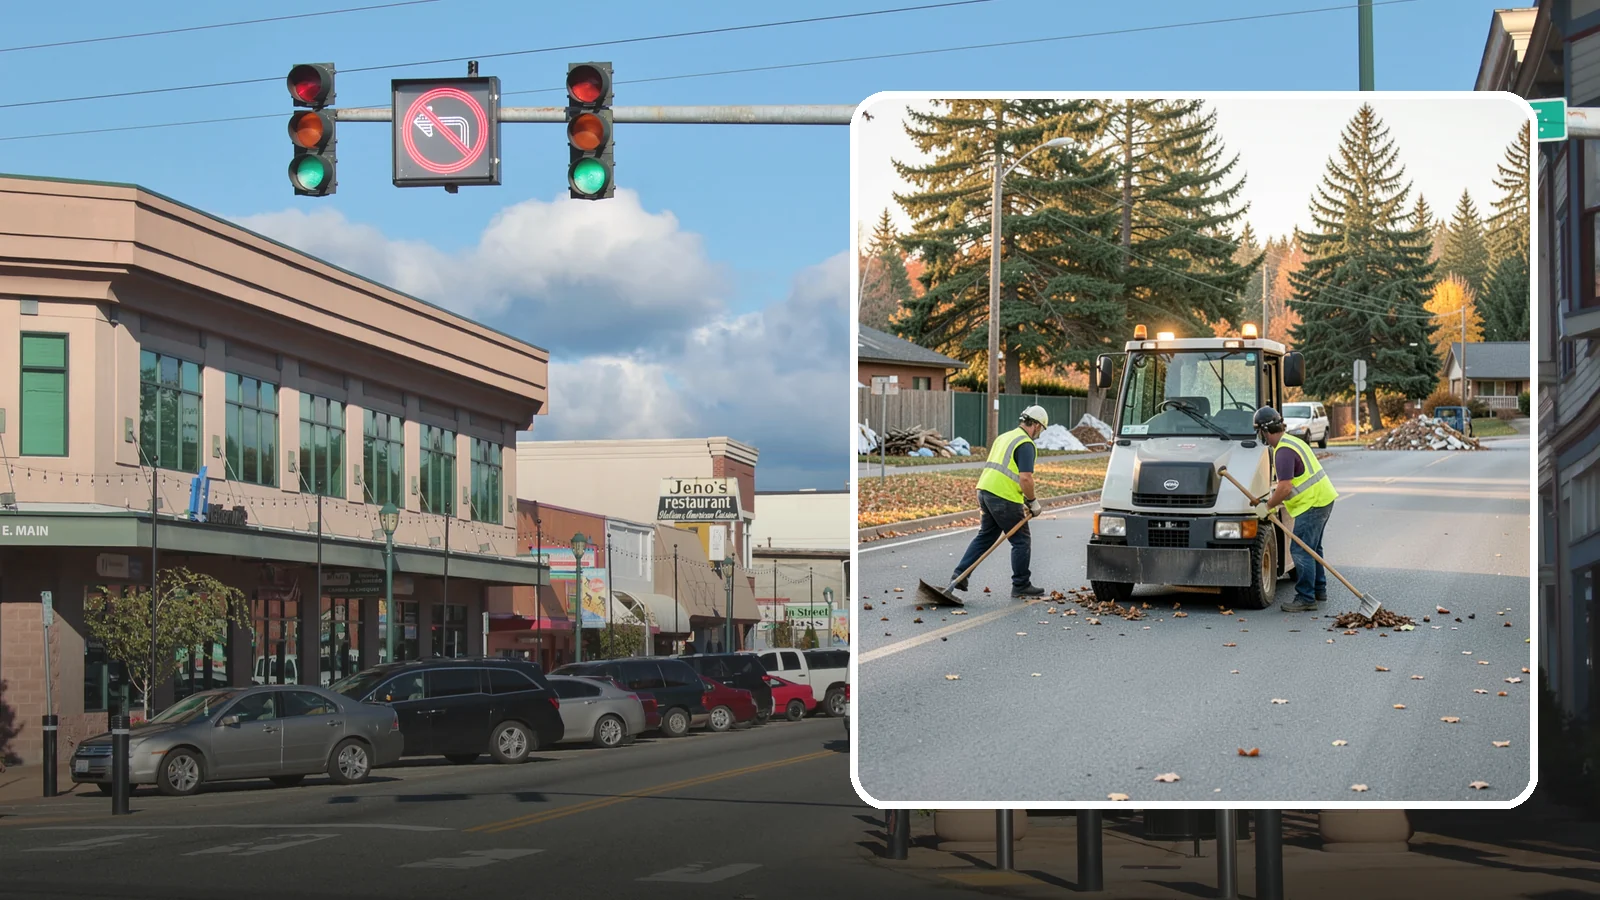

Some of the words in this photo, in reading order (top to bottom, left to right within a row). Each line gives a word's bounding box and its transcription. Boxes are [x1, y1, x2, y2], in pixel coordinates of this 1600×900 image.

[670, 480, 727, 495] Jeno's
[665, 496, 731, 509] restaurant
[658, 510, 681, 520] Italian
[686, 510, 714, 519] American
[714, 509, 737, 519] Cuisine
[2, 525, 13, 536] E.
[15, 525, 49, 536] MAIN
[797, 607, 828, 617] Street
